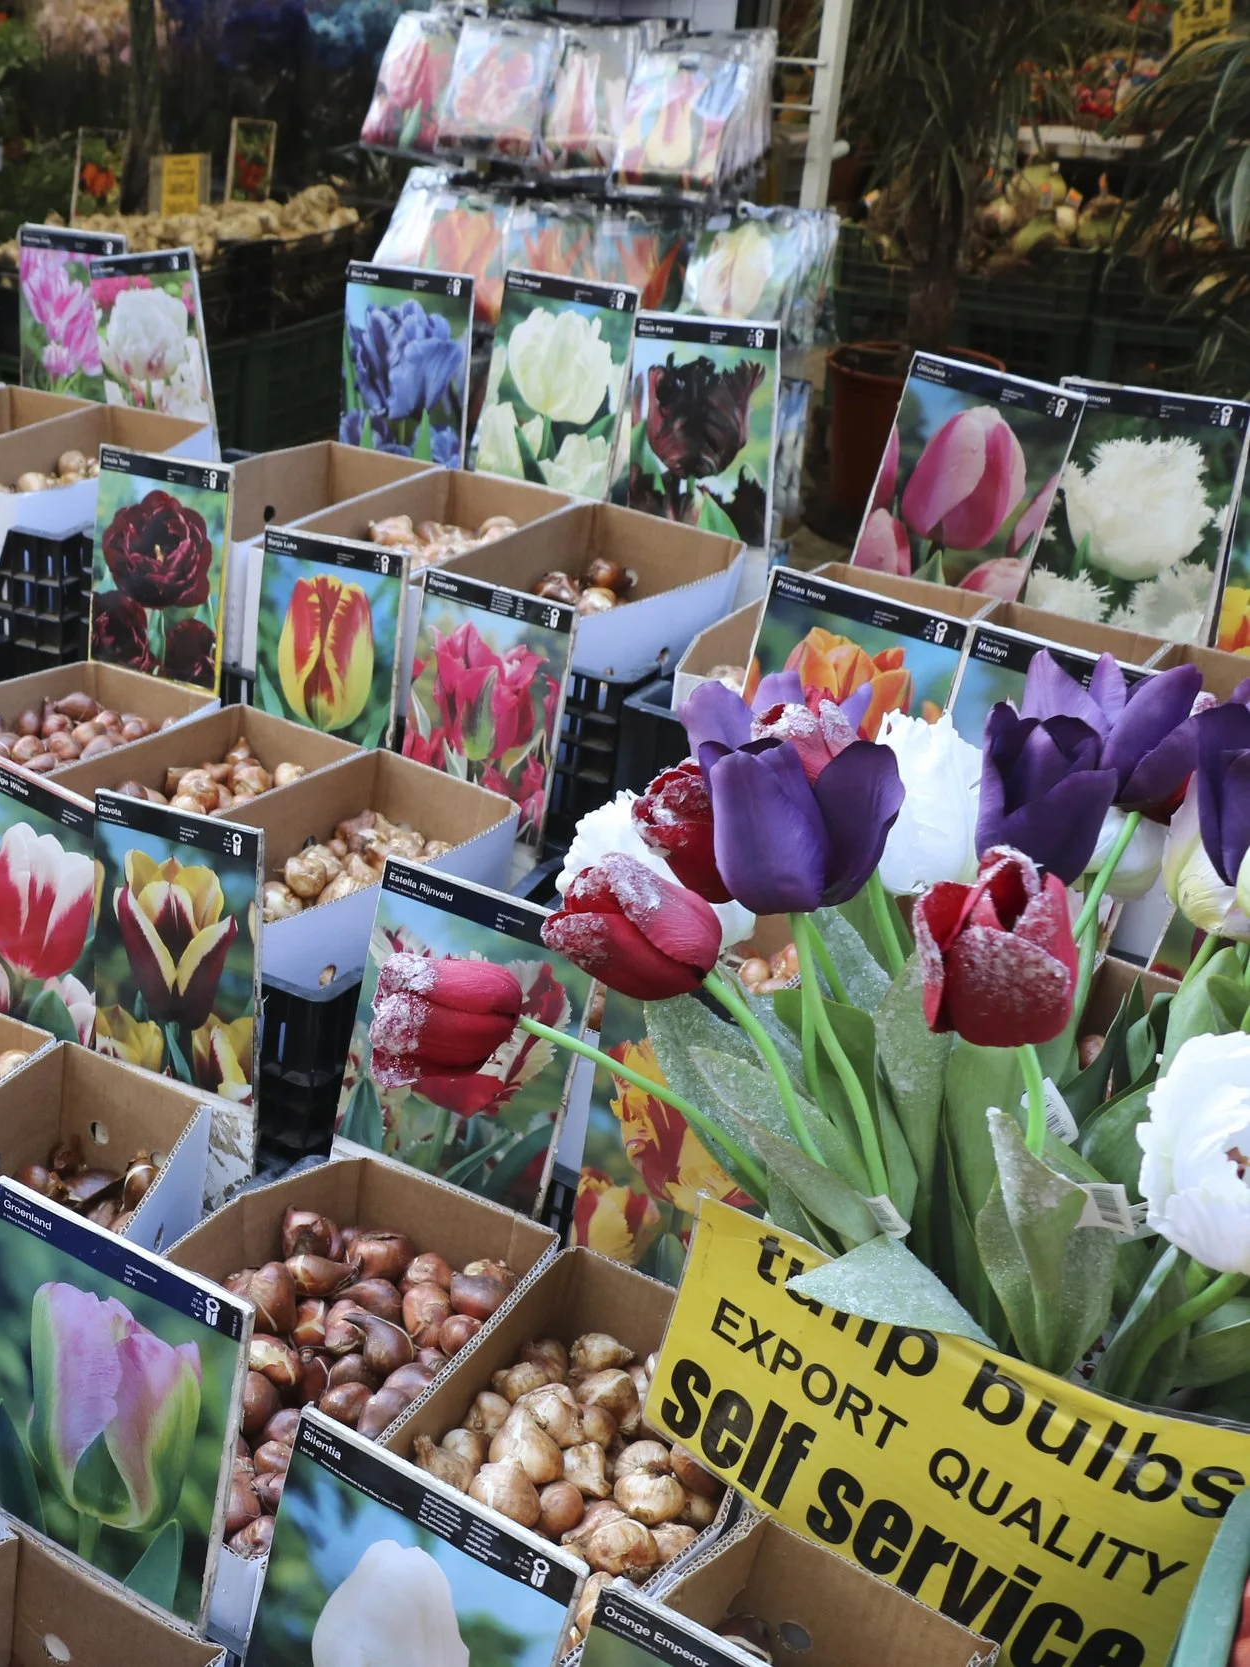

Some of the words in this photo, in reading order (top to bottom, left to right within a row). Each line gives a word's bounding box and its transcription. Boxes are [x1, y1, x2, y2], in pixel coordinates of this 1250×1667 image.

[363, 272, 379, 280] Parrot
[508, 276, 524, 285] White
[524, 279, 541, 289] Parrot
[639, 324, 655, 332] Black
[656, 326, 674, 334] Parrot
[103, 455, 118, 465] Uncle
[118, 458, 130, 467] Tom
[267, 538, 283, 549] Banja
[283, 540, 298, 551] Luka
[428, 576, 458, 593] Esperanto
[777, 579, 805, 596] Prinses
[806, 588, 826, 601] Irene
[977, 641, 1008, 658] Marilyn
[9, 781, 29, 796] Witwe
[98, 803, 122, 817] Gavota
[389, 871, 418, 890] Estella
[419, 882, 454, 903] Rijnveld
[3, 1199, 52, 1231] Groenland
[303, 1430, 342, 1461] Silentia
[710, 1297, 909, 1449] EXPORT
[928, 1447, 1189, 1596] QUALITY
[962, 1358, 1247, 1519] bulbs
[661, 1358, 818, 1511] self
[806, 1467, 1145, 1667] service
[604, 1605, 651, 1638] Orange
[654, 1632, 710, 1667] Emperor
